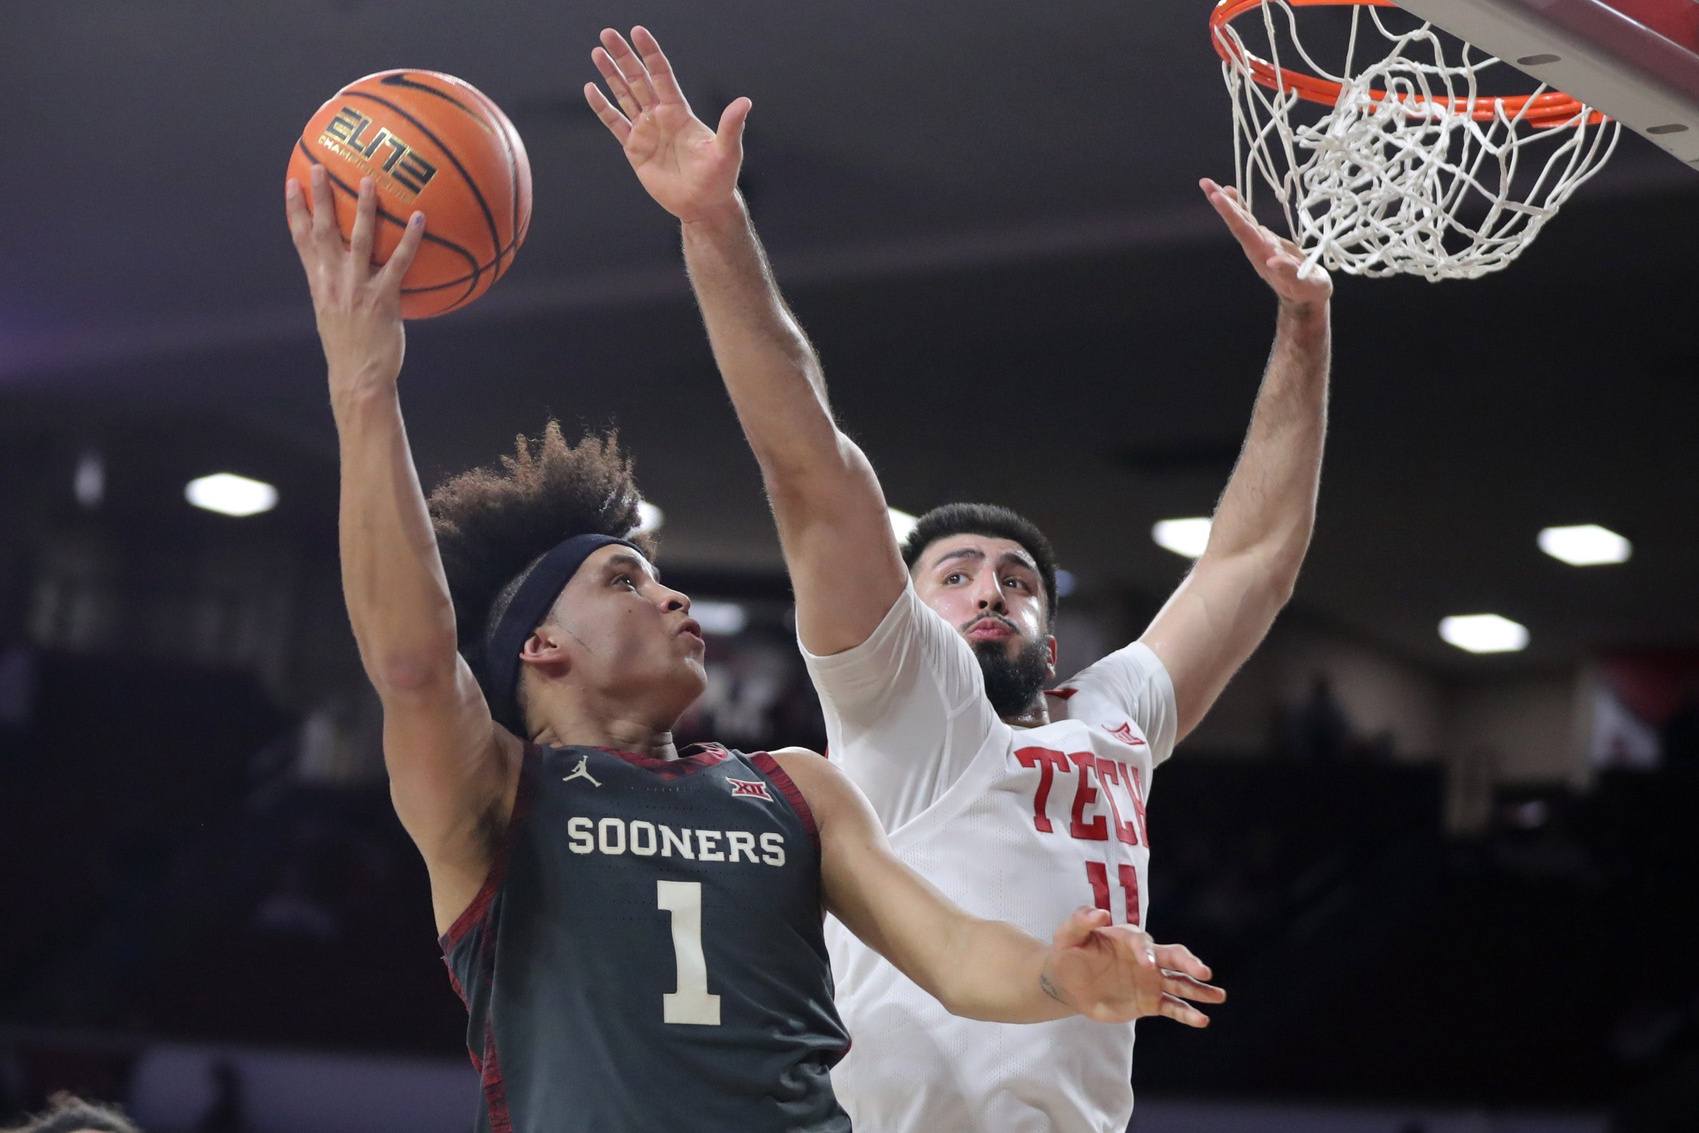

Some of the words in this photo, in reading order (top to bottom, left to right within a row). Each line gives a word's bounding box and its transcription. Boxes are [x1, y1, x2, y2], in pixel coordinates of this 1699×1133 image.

[324, 105, 438, 197] ELITE
[726, 777, 773, 802] XII
[1013, 746, 1150, 848] TECH
[567, 816, 786, 867] SOONERS
[1085, 860, 1140, 926] 11
[656, 879, 721, 1026] 1
